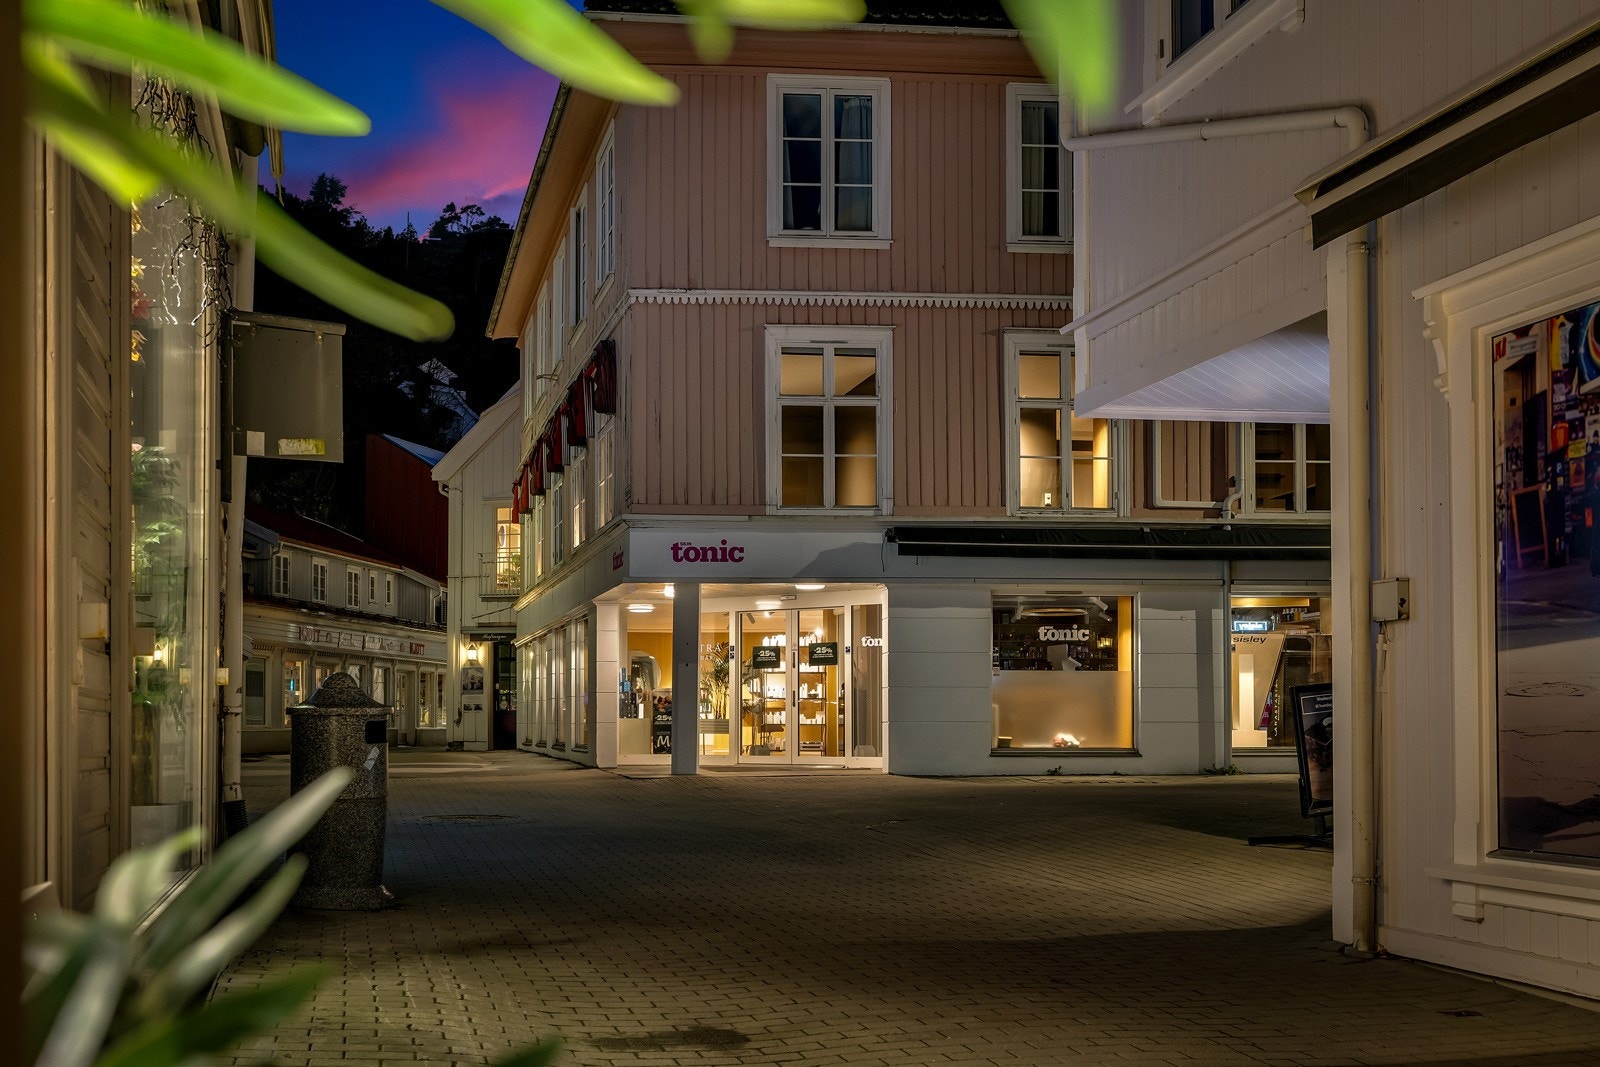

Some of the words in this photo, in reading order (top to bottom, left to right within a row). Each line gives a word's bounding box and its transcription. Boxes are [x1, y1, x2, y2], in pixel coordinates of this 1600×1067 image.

[671, 539, 744, 563] tonic
[1038, 623, 1090, 641] tonic
[1232, 636, 1266, 645] sisley
